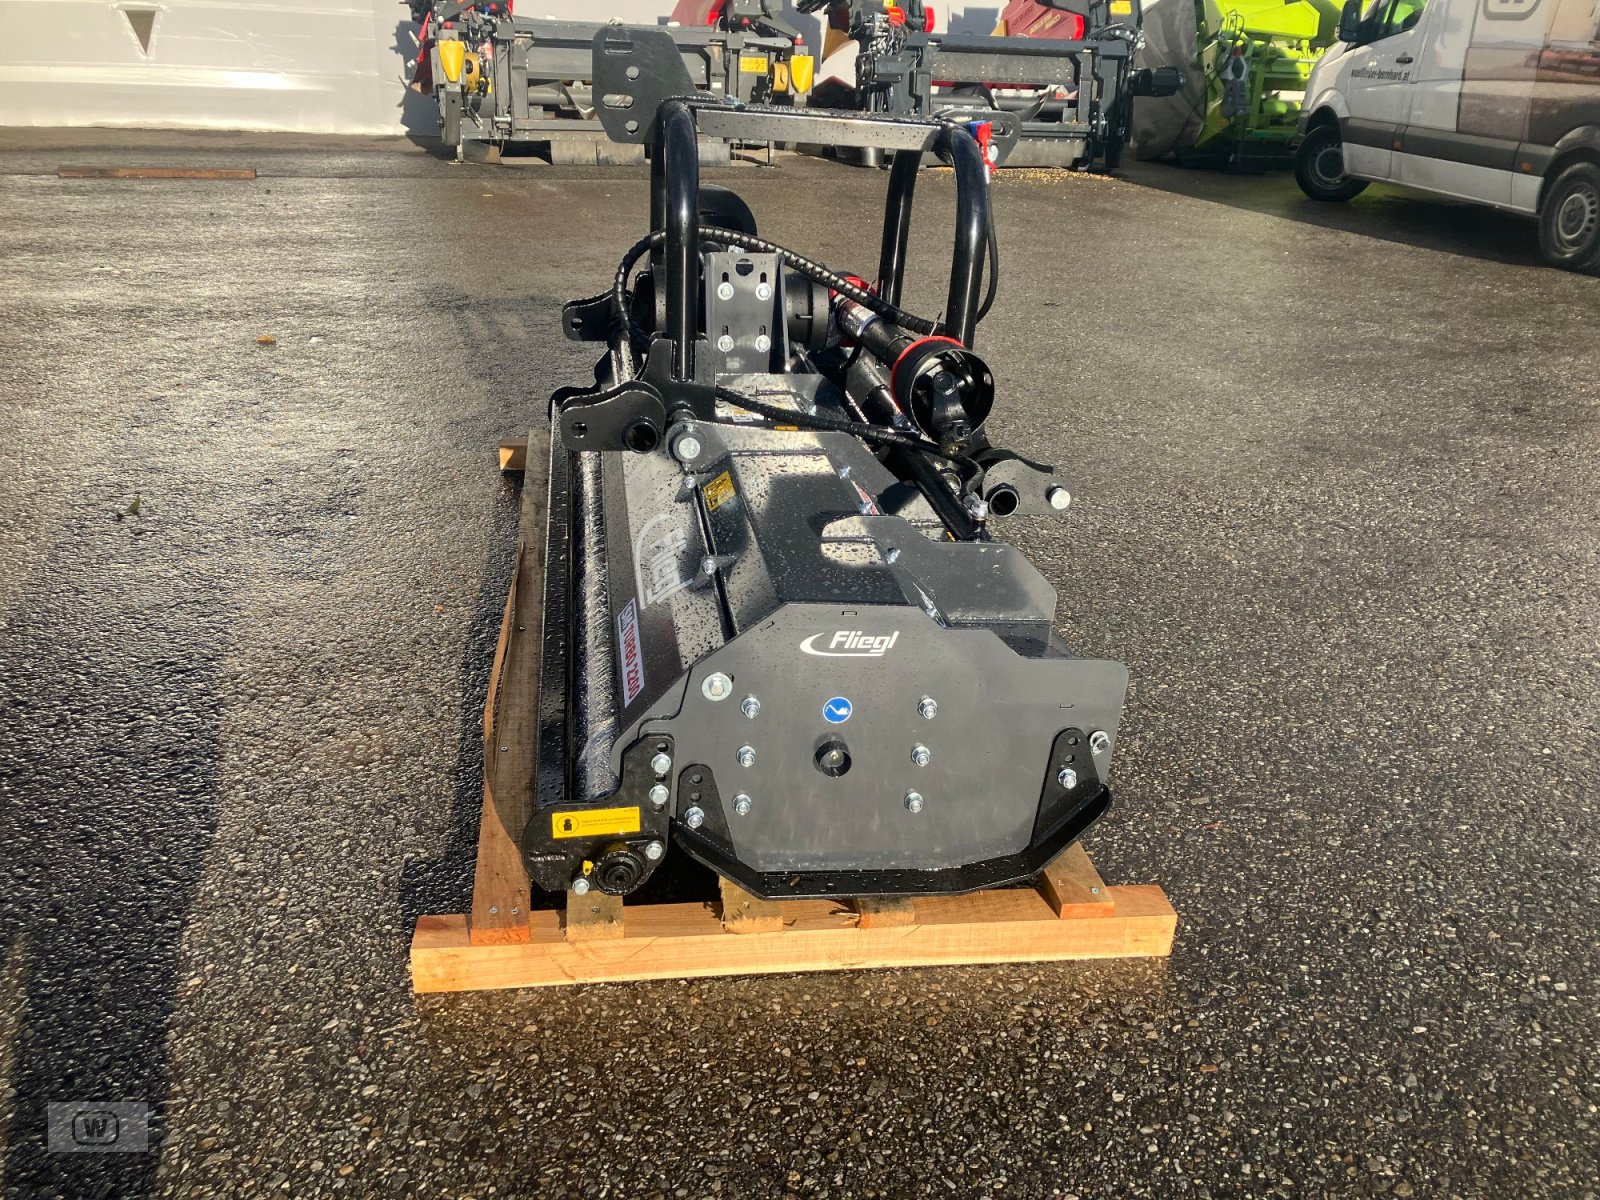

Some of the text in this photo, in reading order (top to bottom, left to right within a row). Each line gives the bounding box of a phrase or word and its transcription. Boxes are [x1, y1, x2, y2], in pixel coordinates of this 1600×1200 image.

[647, 527, 693, 604] Fliegl
[623, 623, 637, 667] TURBO
[829, 630, 900, 653] Fliegl
[627, 662, 640, 699] 2200
